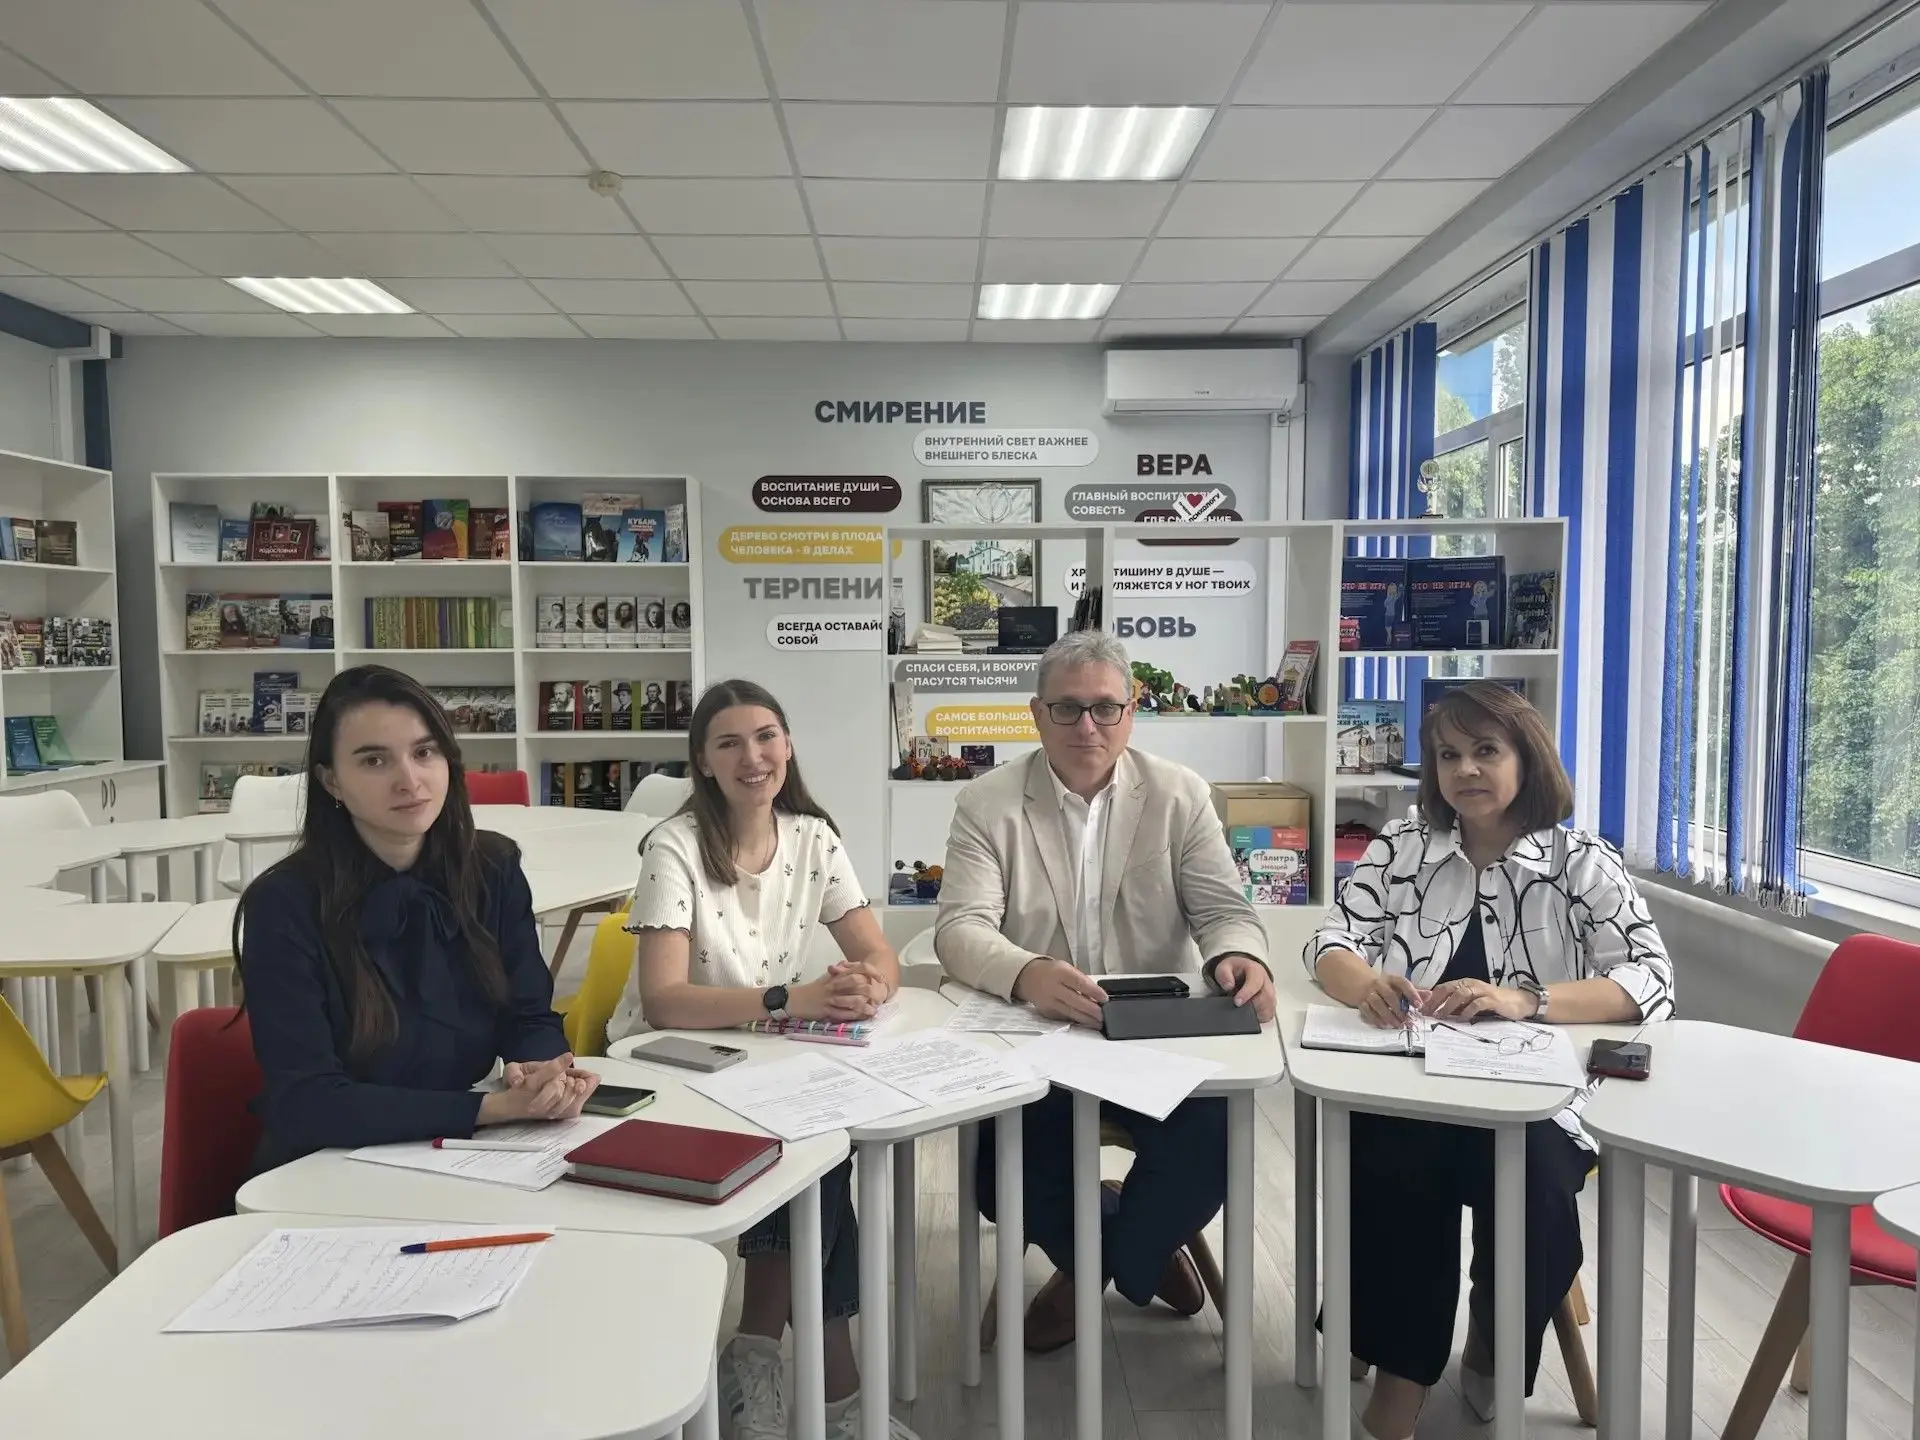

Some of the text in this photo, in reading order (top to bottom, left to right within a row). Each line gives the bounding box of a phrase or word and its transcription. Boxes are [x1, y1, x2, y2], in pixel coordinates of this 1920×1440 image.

[815, 400, 986, 424] СМИРЕНИЕ
[925, 435, 1088, 446] ВНУТРЕННИЙ СВЕТ ВАЖНЕЕ
[925, 451, 1038, 460] ВНЕШНЕГО БЛЕСКА
[1137, 454, 1213, 475] ВЕРА
[761, 482, 841, 492] ВОСПИТАНИЕ
[842, 482, 880, 493] ДУШИ
[1072, 489, 1209, 501] ГЛАВНЫЙ ВОСПИТА
[761, 496, 851, 506] ОСНОВА ВСЕГО
[1072, 505, 1126, 515] СОВЕСТЬ
[731, 531, 883, 542] ДЕРЕВО СМОТРИ В ПЛОДА
[731, 545, 794, 555] ЧЕЛОВЕКА
[804, 545, 811, 555] В
[812, 545, 854, 556] ДЕЛАХ
[1114, 567, 1164, 577] ТИШИНУ
[1166, 568, 1173, 576] В
[1175, 567, 1211, 578] ДУШЕ
[1175, 581, 1184, 590] У
[1185, 581, 1209, 590] НОГ
[1212, 580, 1251, 589] ТВОИХ
[1449, 582, 1471, 590] ИГРА
[777, 619, 883, 632] ВСЕГДА ОСТАВАЙ
[1112, 616, 1197, 638] БОВЬ
[777, 634, 818, 645] СОБОЙ
[906, 663, 1037, 674] СПАСИ СЕБЯ, И ВОКРУГ
[969, 676, 1018, 685] ТЫСЯЧИ
[935, 712, 976, 722] САМОЕ
[935, 725, 1036, 735] ВОСПИТАННОСТЬ
[1254, 851, 1295, 863] Палитра
